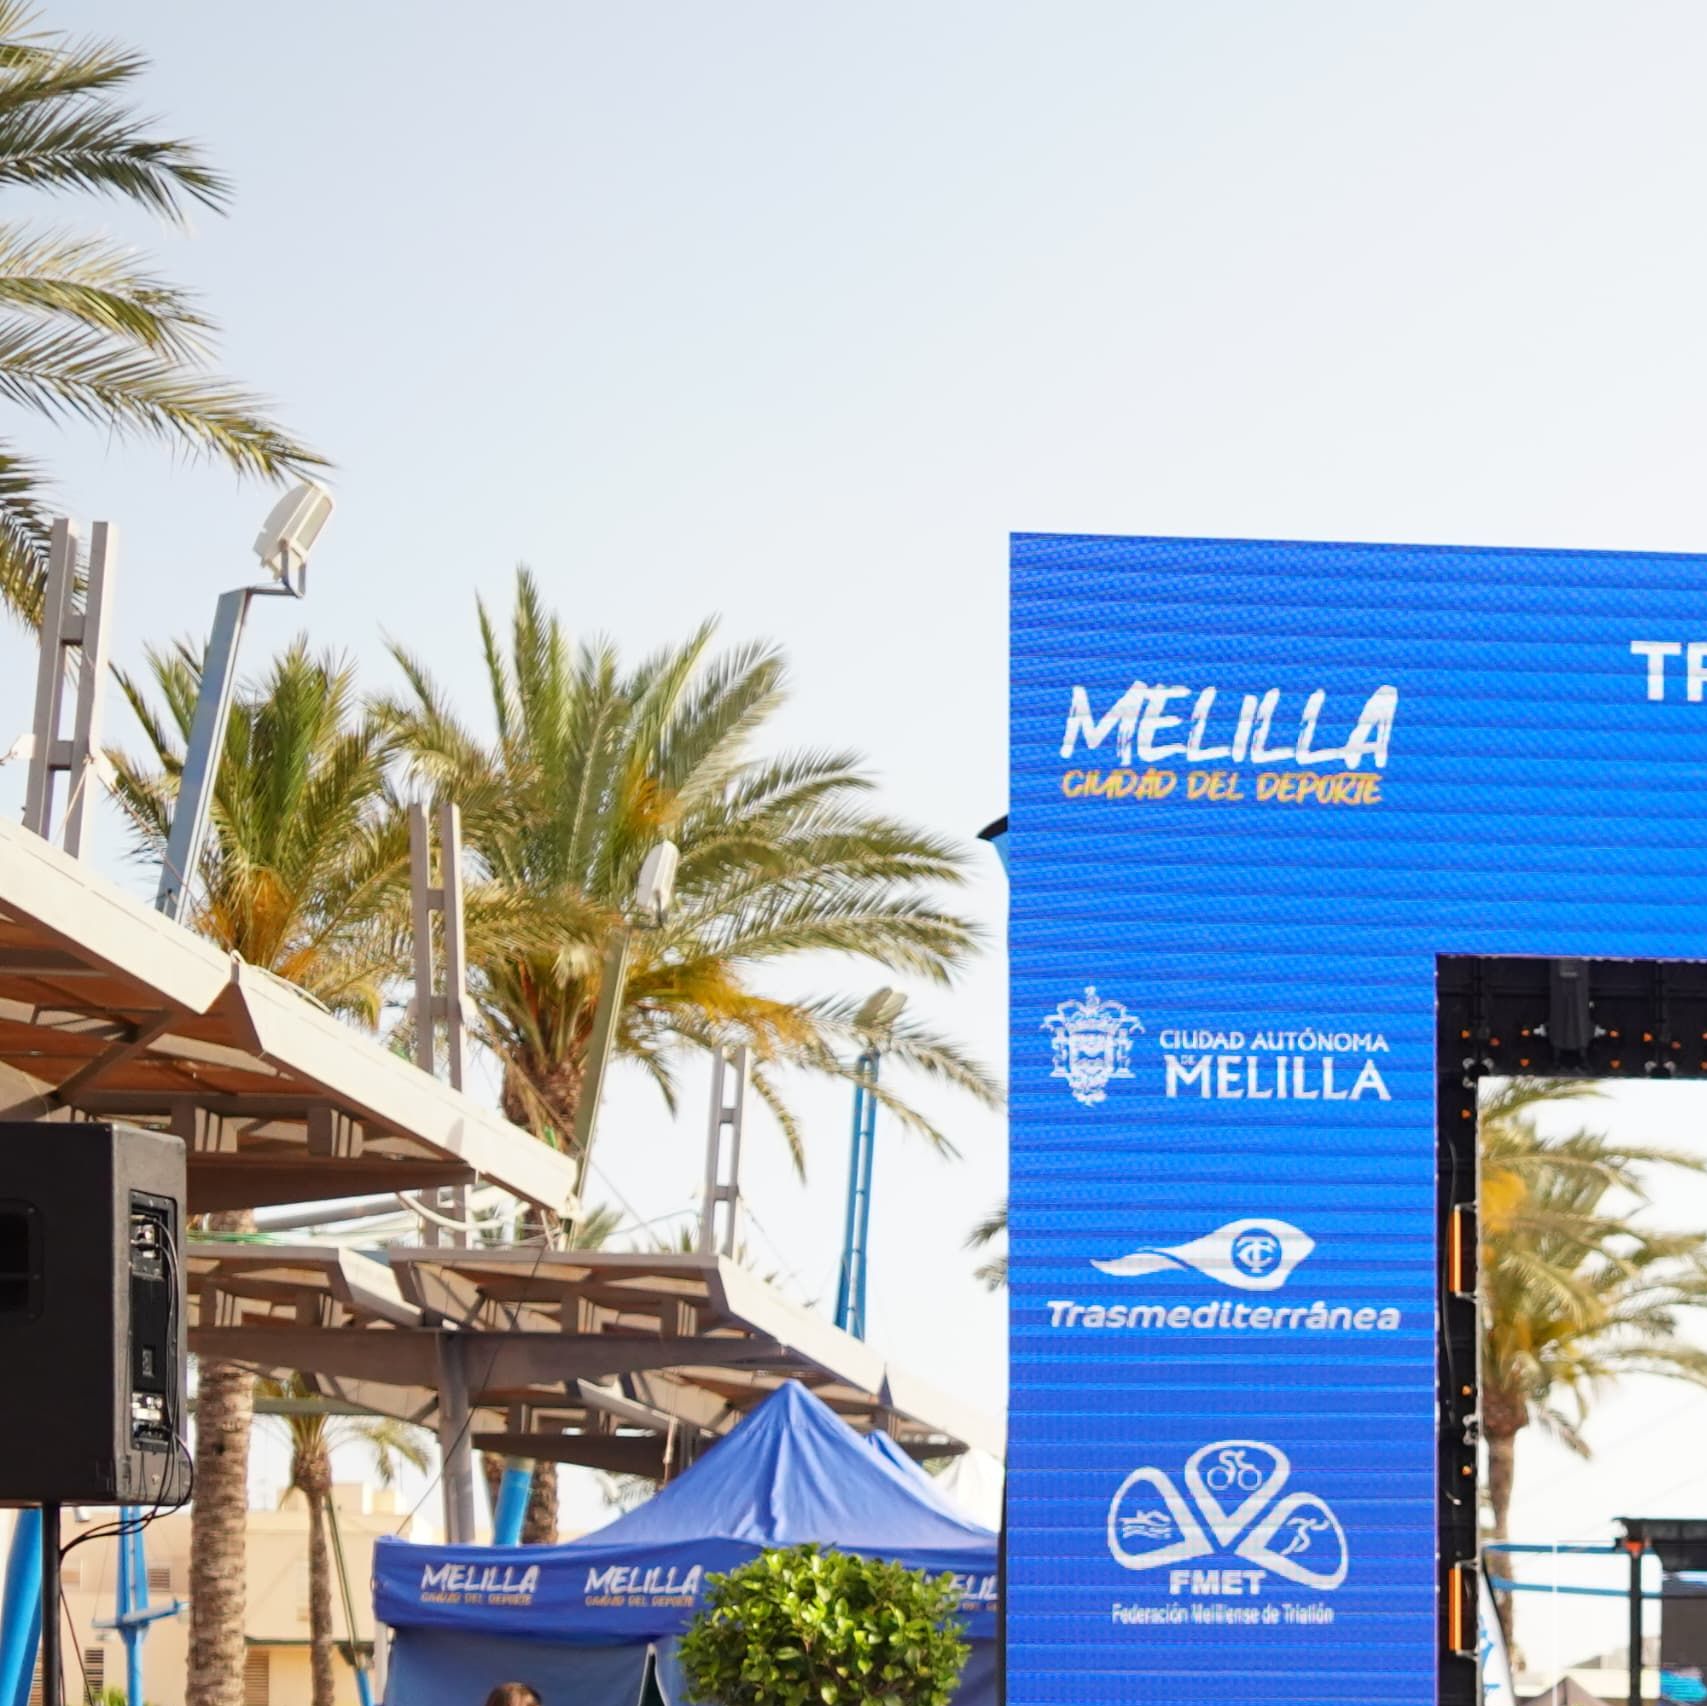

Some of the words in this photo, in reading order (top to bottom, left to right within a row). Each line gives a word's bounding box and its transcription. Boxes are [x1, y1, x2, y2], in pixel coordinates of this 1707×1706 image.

[1059, 680, 1398, 769] MELILLA
[1062, 769, 1179, 800] CIUDAD
[1187, 771, 1244, 801] DEL
[1257, 771, 1383, 804] DEPORTE
[1160, 1030, 1245, 1050] CIUDAD
[1250, 1026, 1390, 1053] AUTÓNOMA
[1165, 1053, 1392, 1102] MELILLA
[1047, 1299, 1401, 1331] Trasmediterránea
[420, 1562, 540, 1593] MELILLA
[584, 1564, 703, 1595] MELILLA
[1169, 1569, 1268, 1595] FMET
[1111, 1601, 1188, 1625] Federación
[1262, 1602, 1280, 1625] de
[1282, 1602, 1335, 1625] Triatlón
